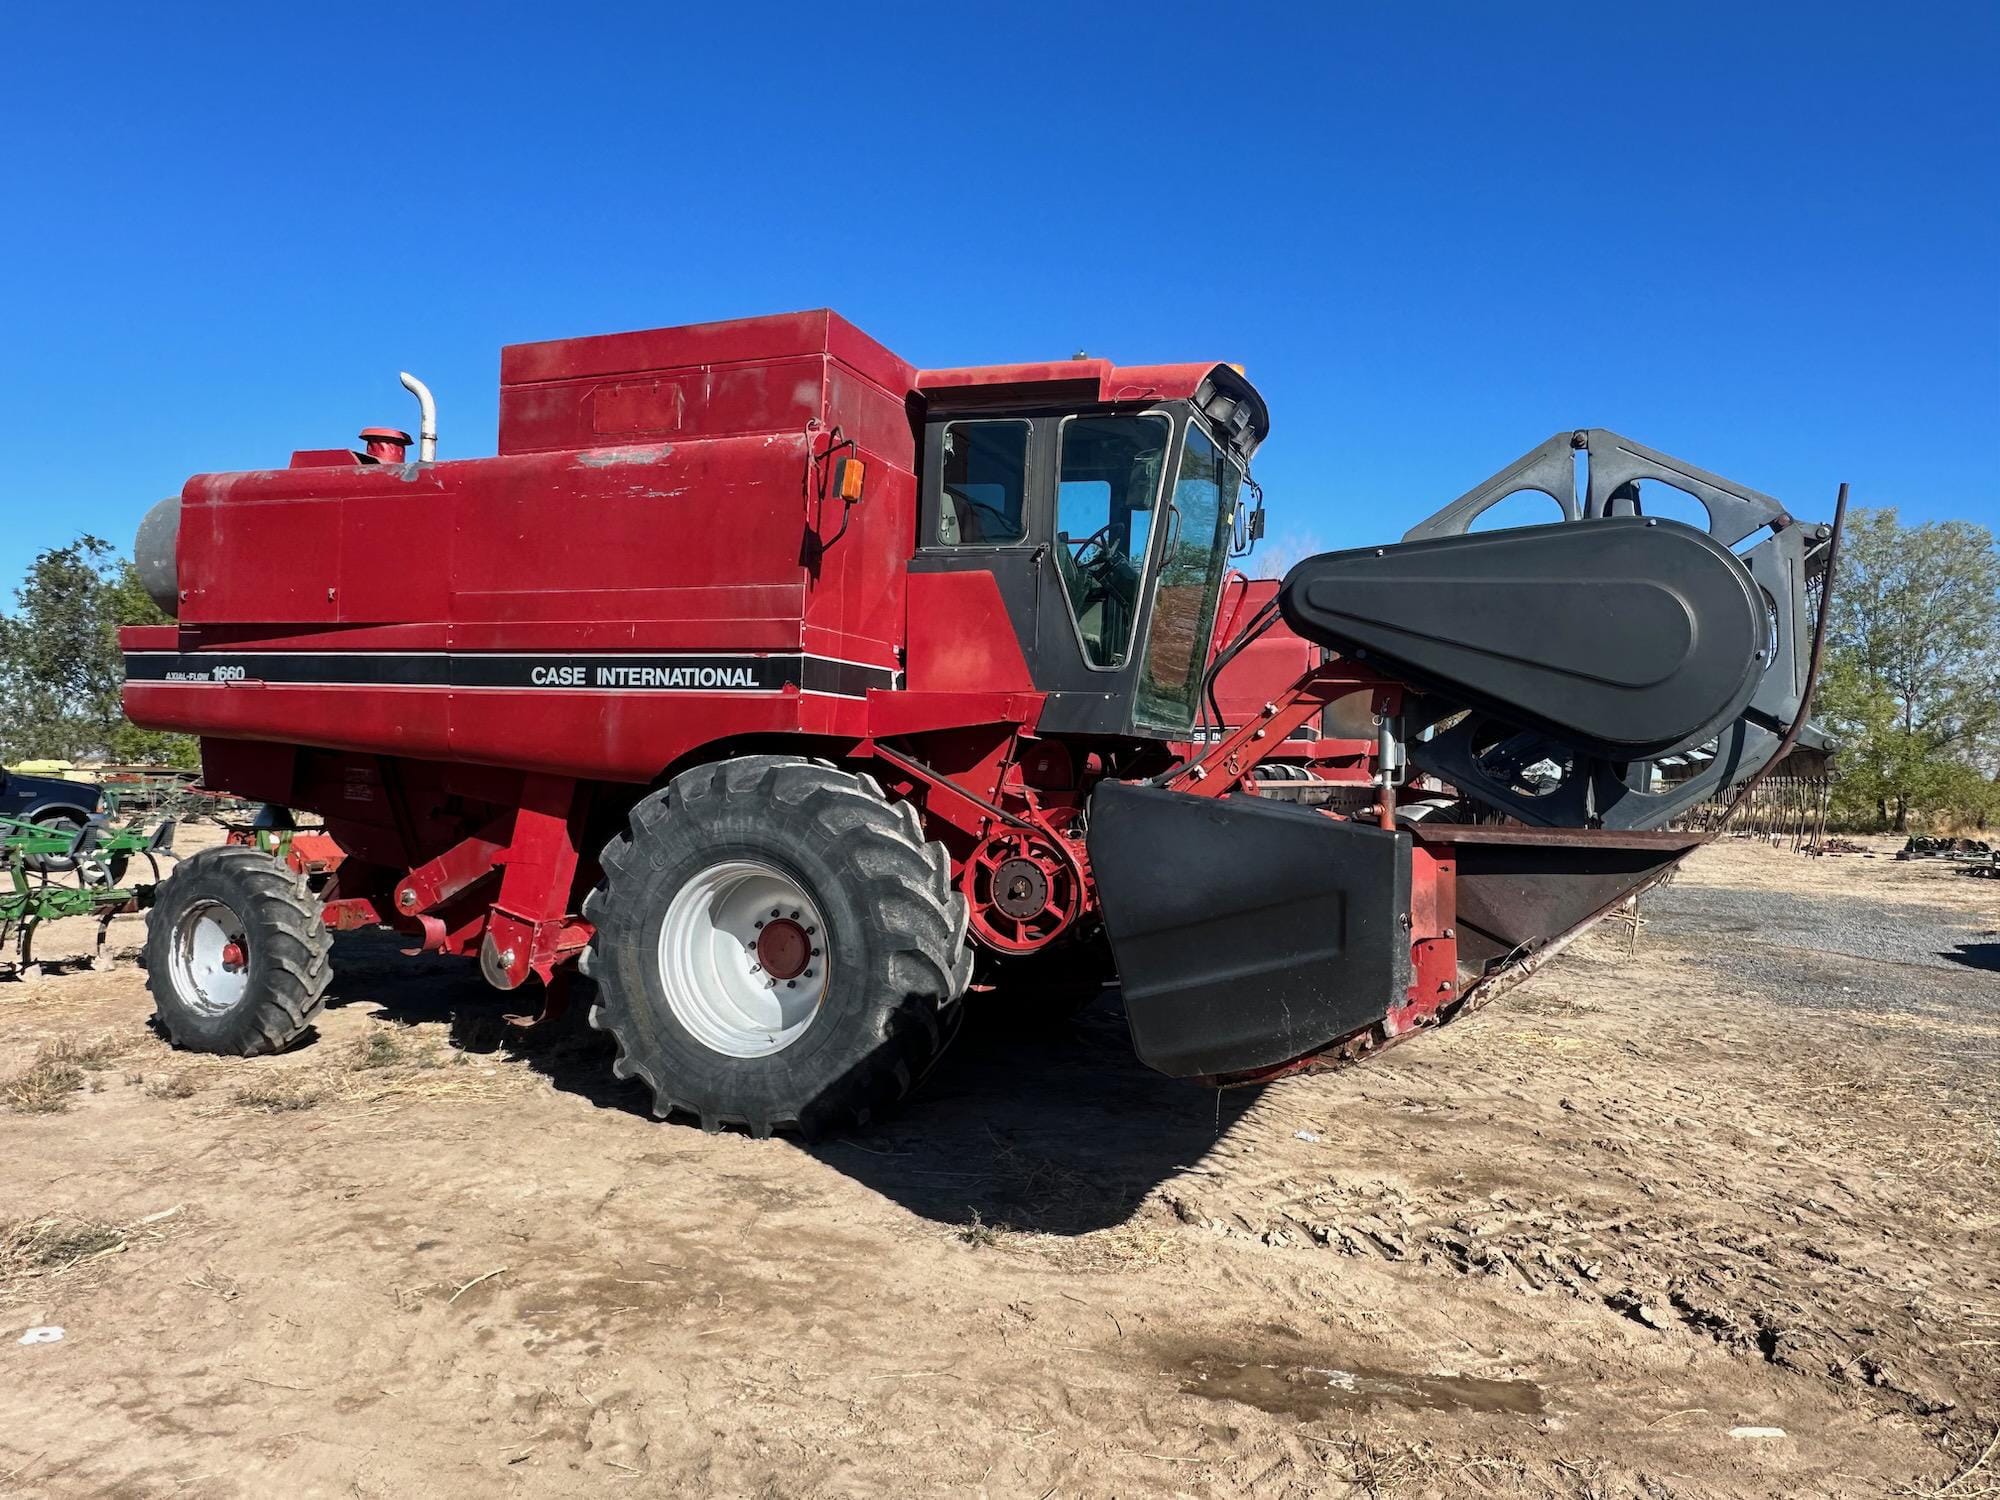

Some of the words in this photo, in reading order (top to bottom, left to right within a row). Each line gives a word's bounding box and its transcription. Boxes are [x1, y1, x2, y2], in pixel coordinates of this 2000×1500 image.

[165, 672, 210, 681] AXIAL-FLOW
[212, 665, 246, 681] 1660
[531, 666, 586, 686] CASE
[596, 667, 760, 687] INTERNATIONAL
